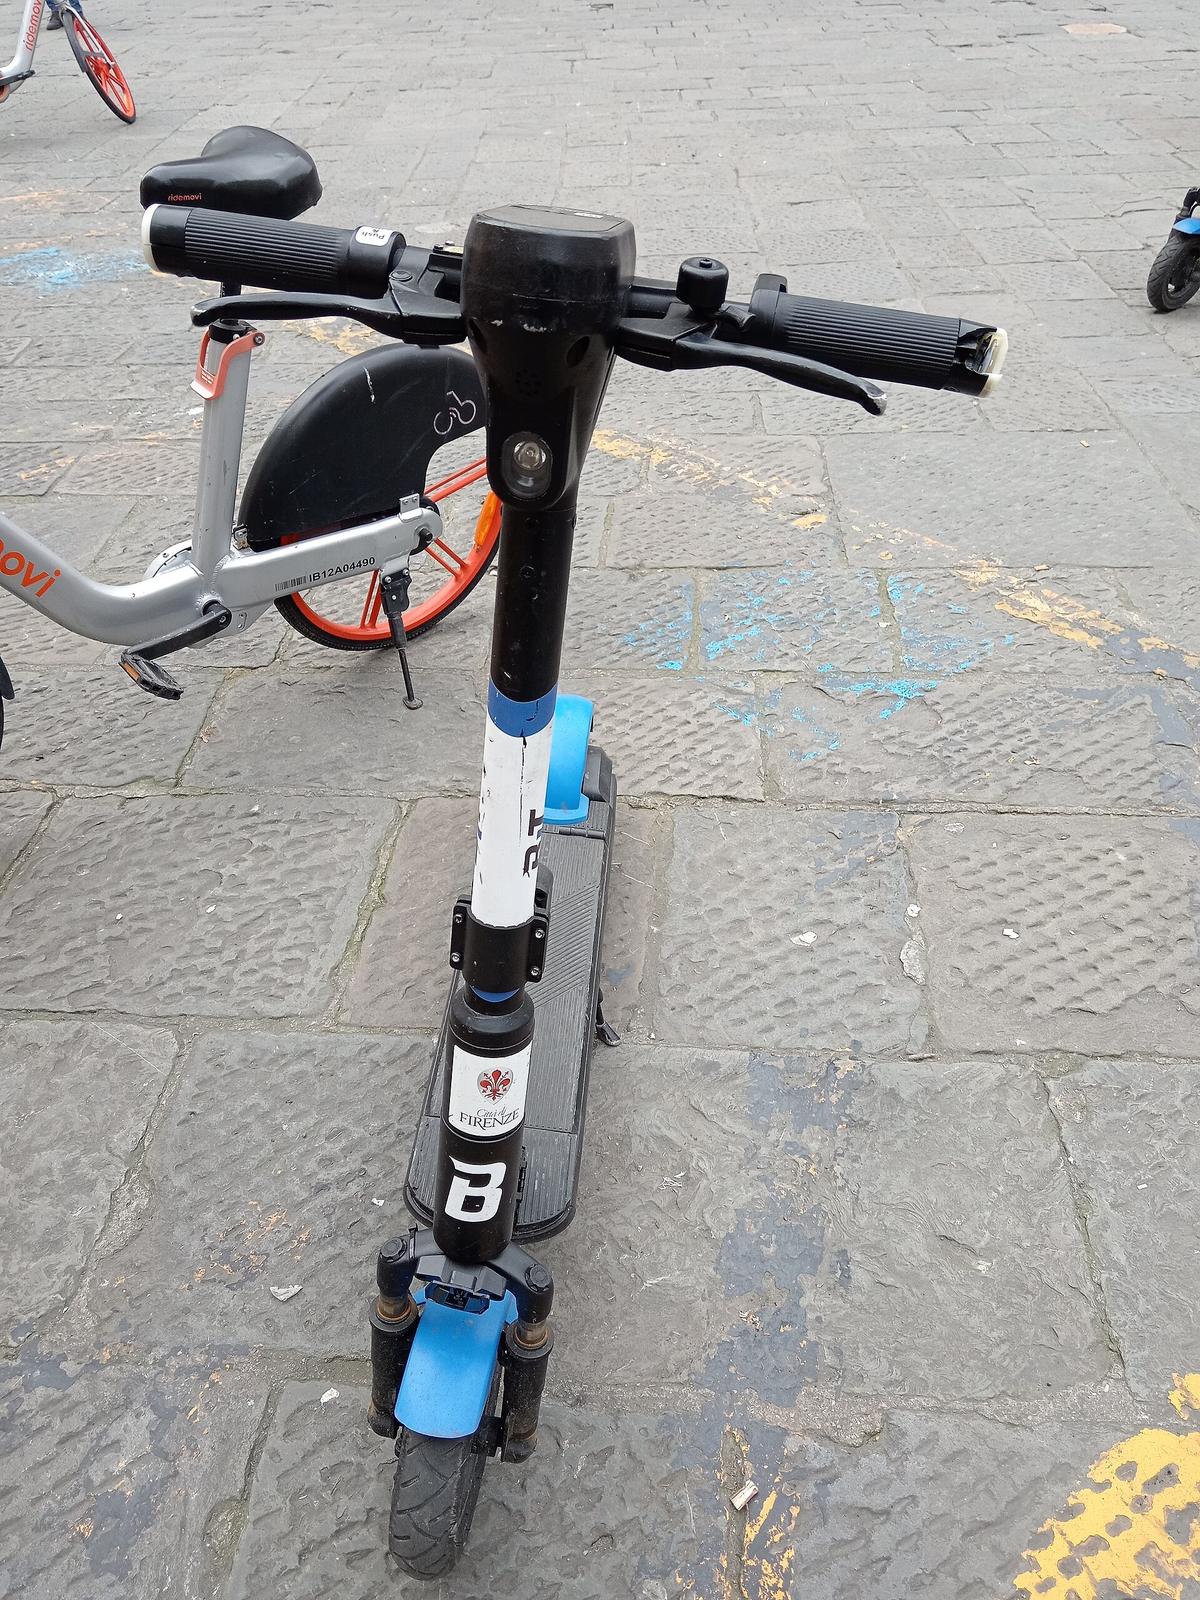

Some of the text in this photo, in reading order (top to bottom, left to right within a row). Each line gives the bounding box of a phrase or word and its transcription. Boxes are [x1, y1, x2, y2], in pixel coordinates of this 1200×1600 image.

[23, 0, 42, 52] ridemov
[168, 193, 202, 201] ridemovi
[0, 537, 62, 598] ovi
[309, 557, 375, 582] IB12A04490
[459, 1108, 520, 1130] FIRENZE
[444, 1155, 507, 1222] B
